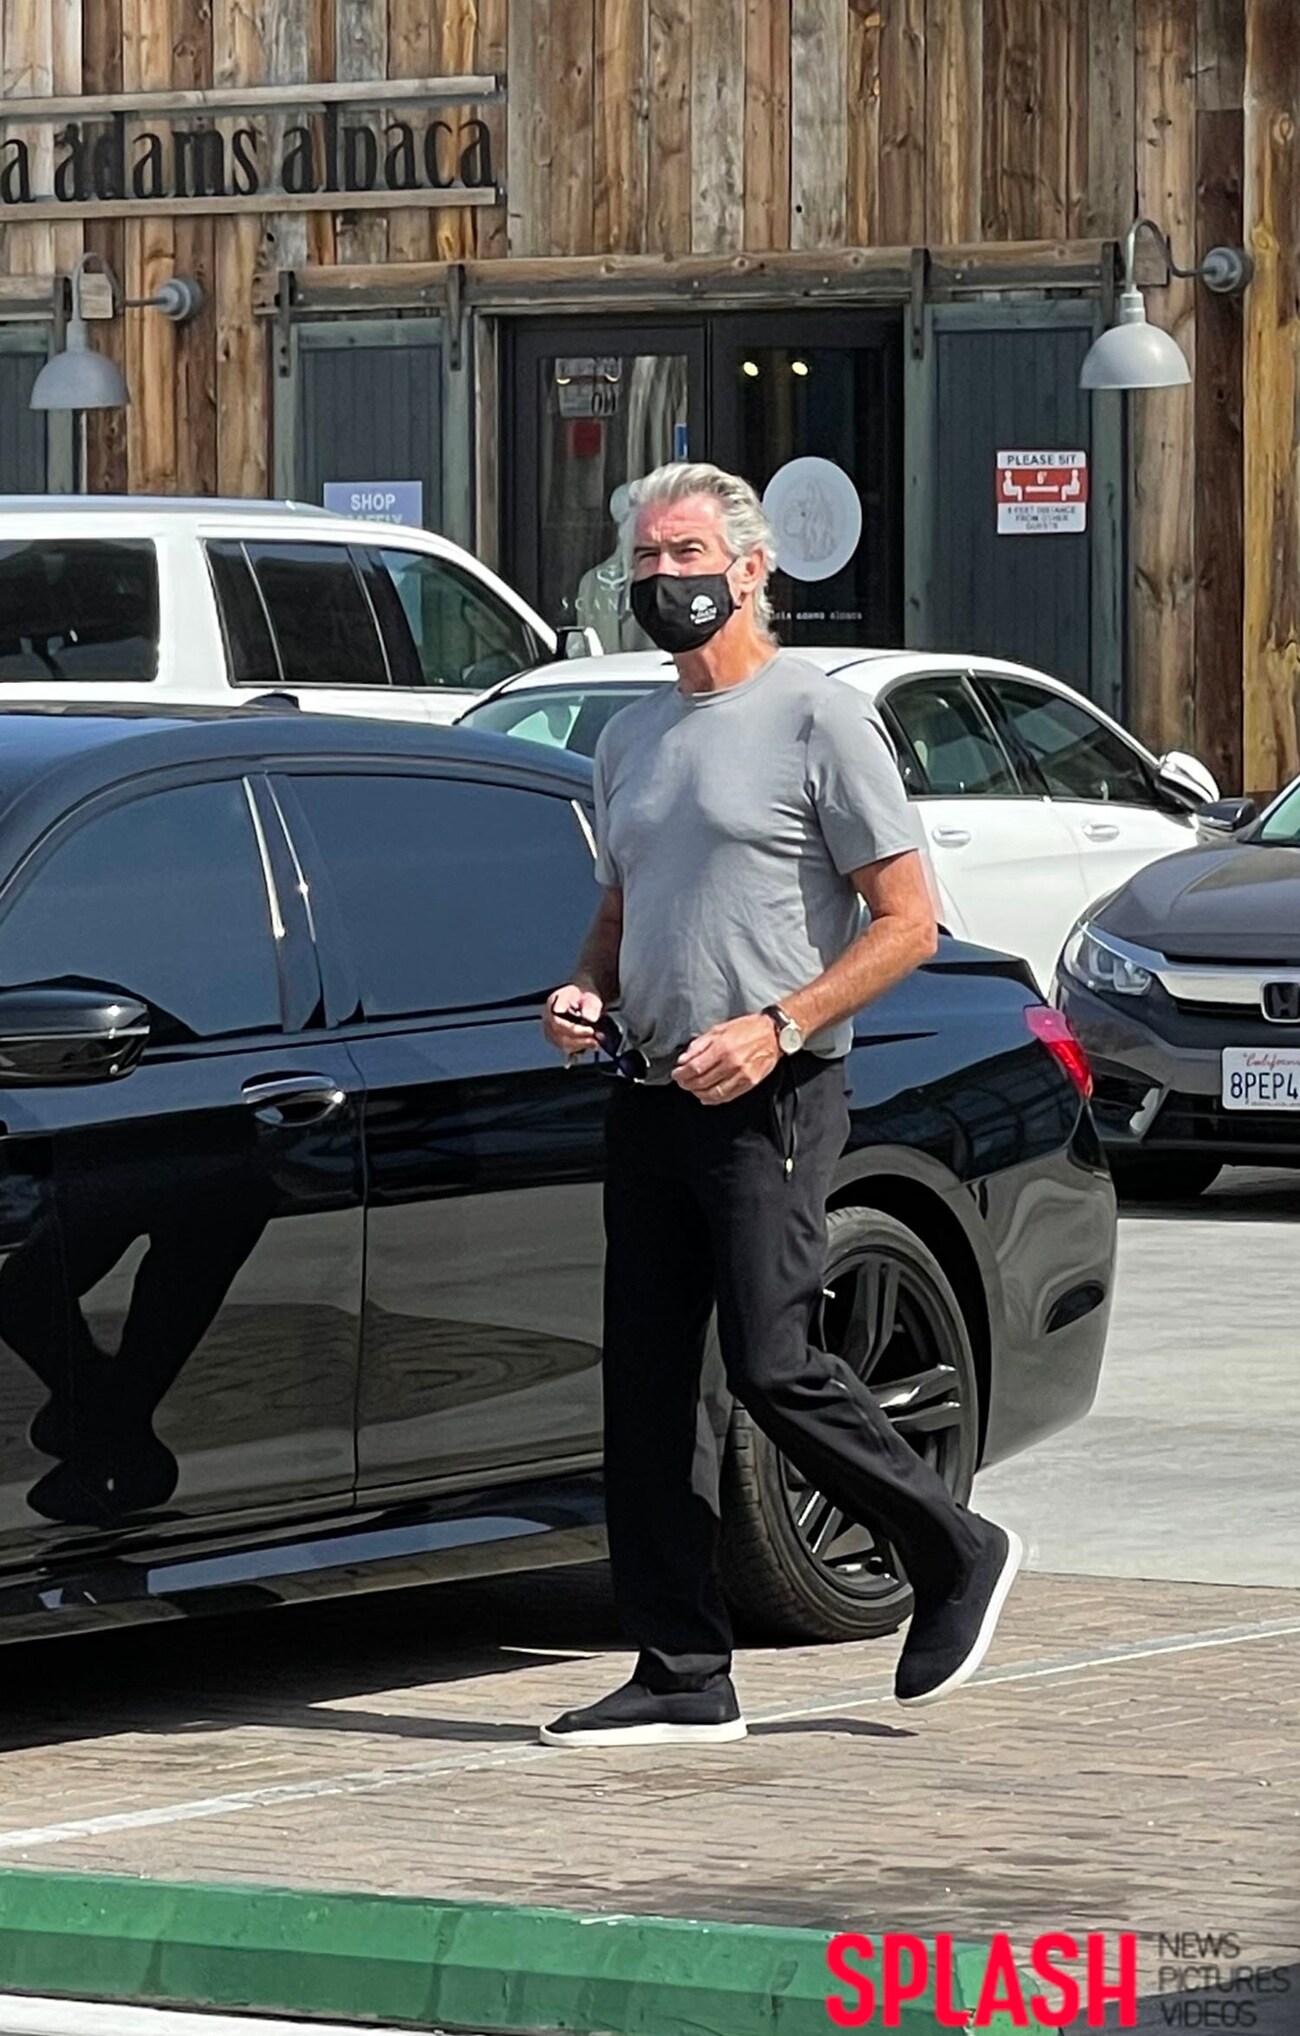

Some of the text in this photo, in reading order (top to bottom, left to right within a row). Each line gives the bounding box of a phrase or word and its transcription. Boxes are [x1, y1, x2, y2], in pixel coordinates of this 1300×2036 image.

[54, 110, 260, 203] adams
[281, 100, 497, 194] alpaca
[1007, 454, 1076, 466] PLEASE SIT
[350, 493, 396, 511] SHOP
[1230, 1071, 1299, 1100] 8PEP4
